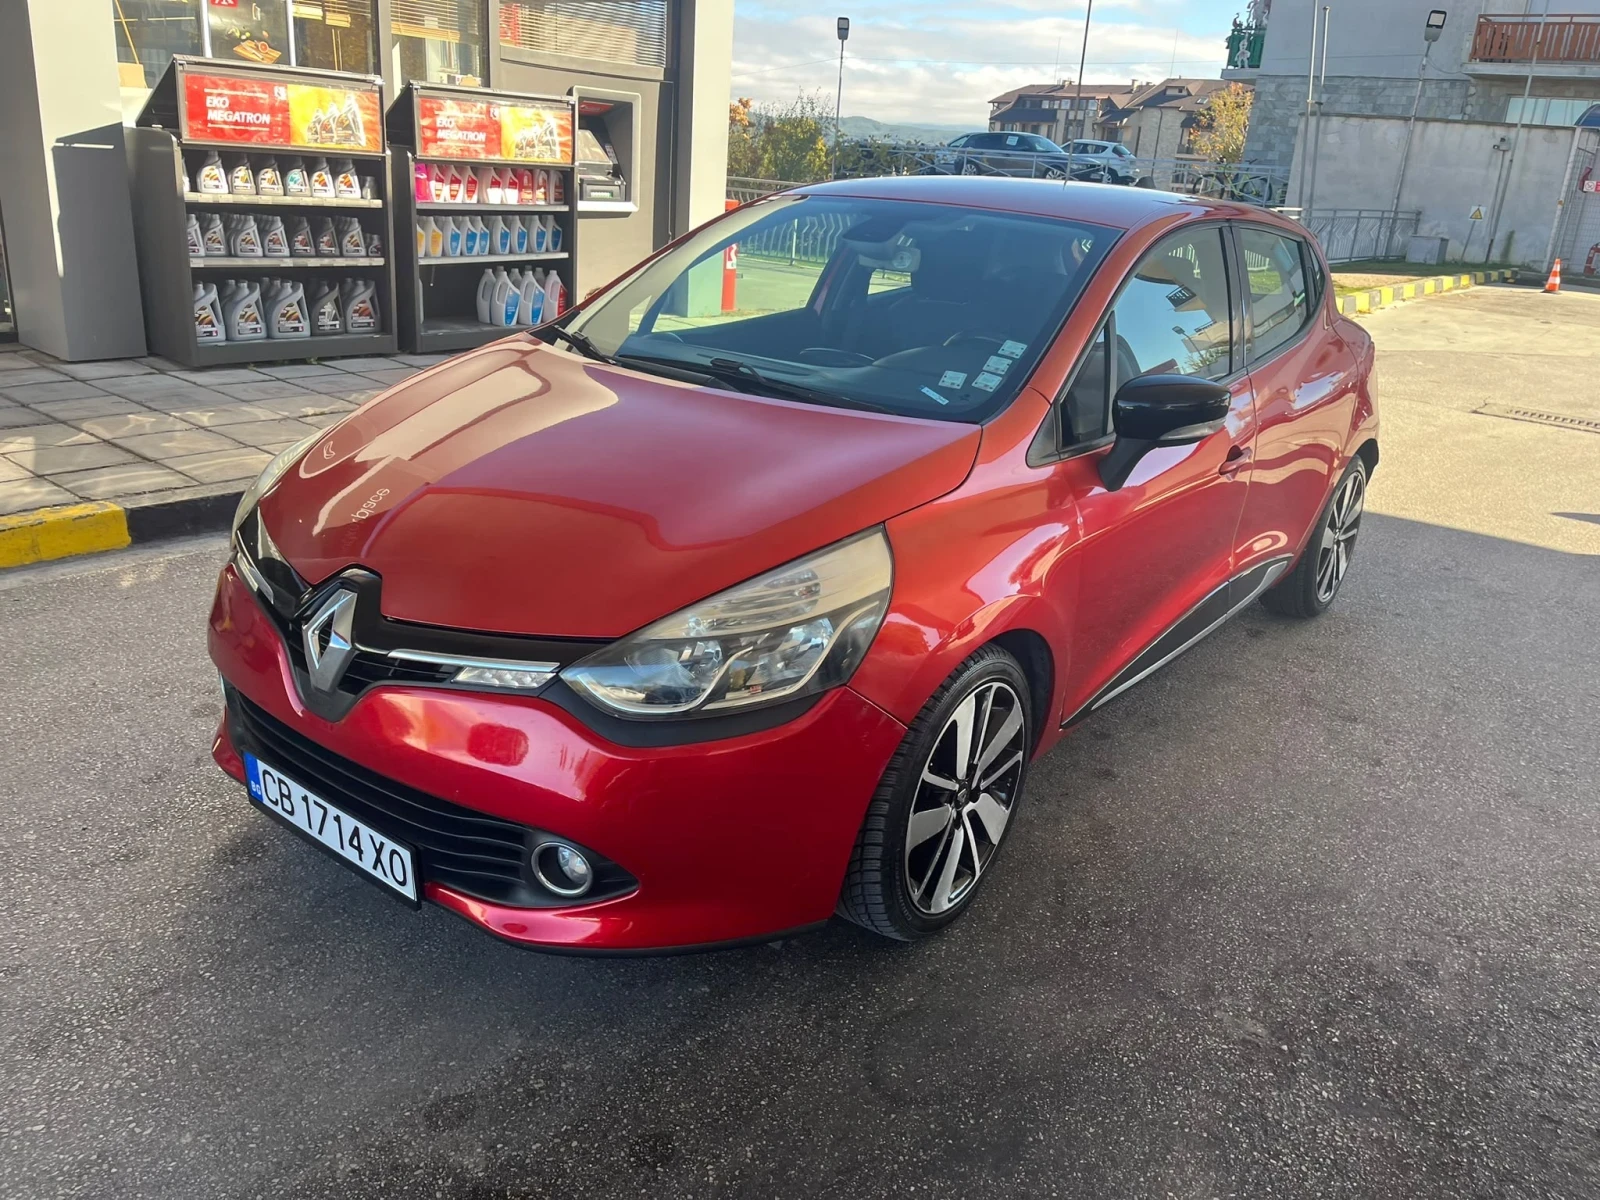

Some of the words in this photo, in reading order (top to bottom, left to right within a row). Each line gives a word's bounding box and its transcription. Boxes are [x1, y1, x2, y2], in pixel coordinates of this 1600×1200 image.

[205, 96, 229, 109] EKO
[207, 110, 271, 124] MEGATRON
[435, 116, 455, 128] EKO
[436, 129, 487, 142] MEGATRON
[251, 780, 262, 795] BG
